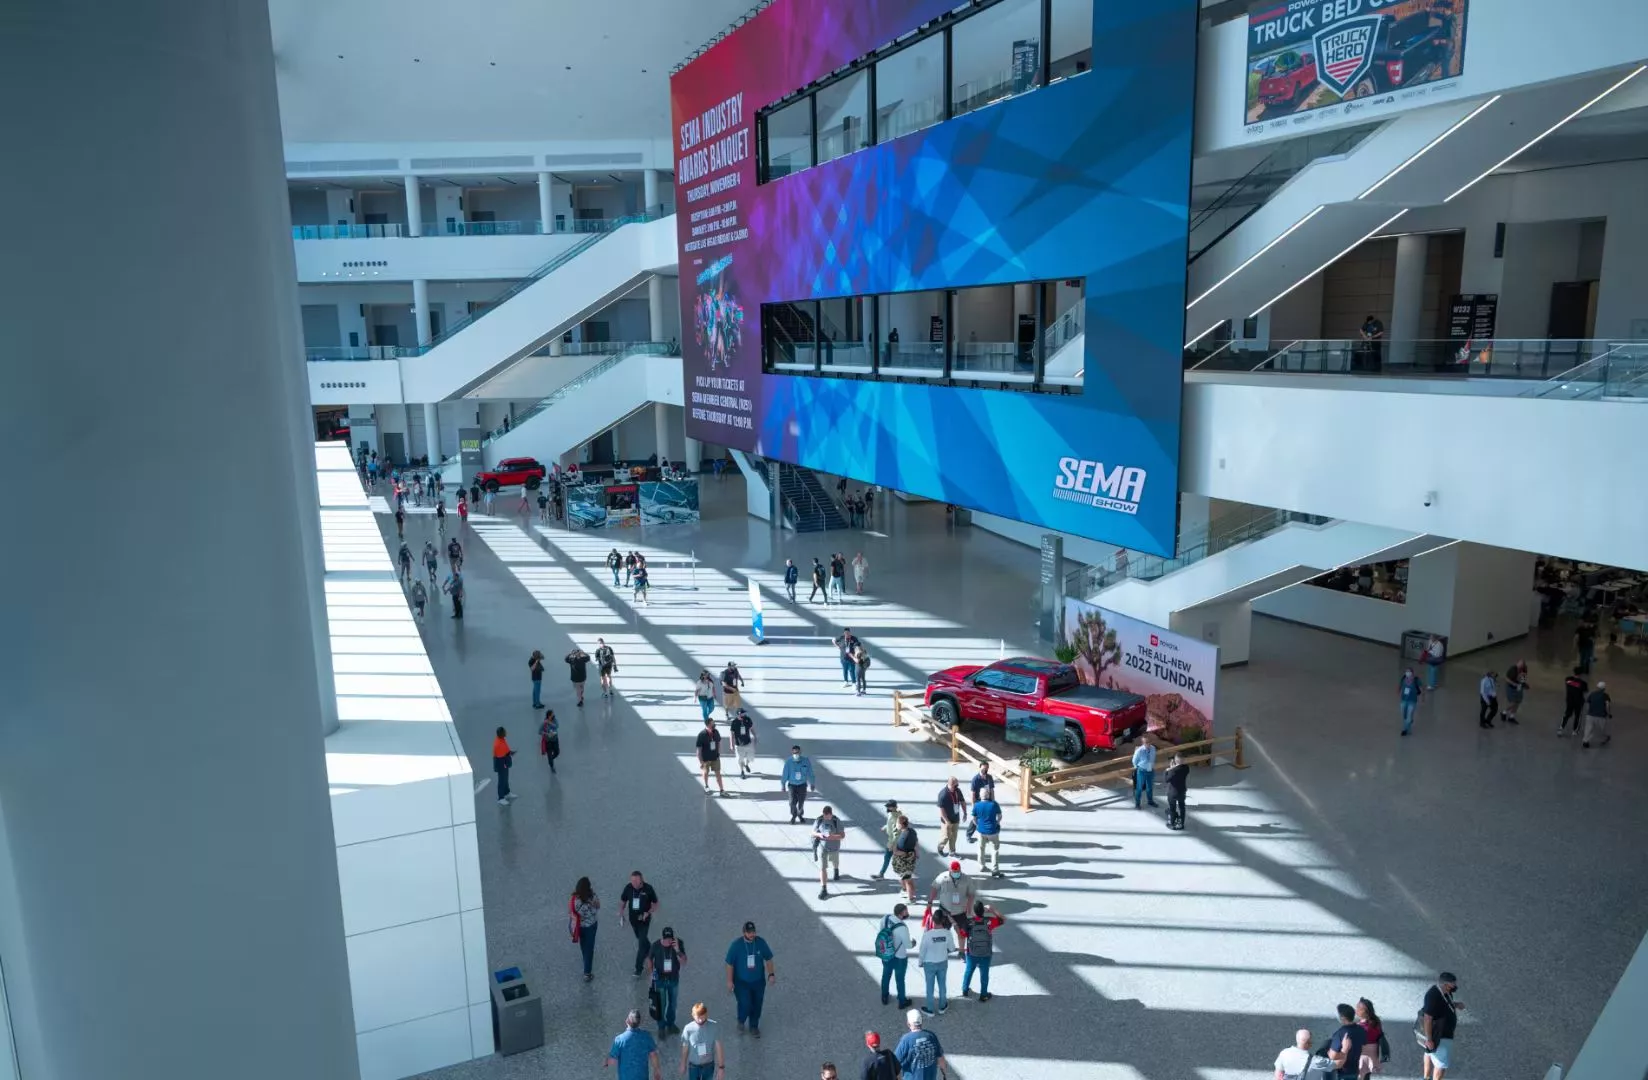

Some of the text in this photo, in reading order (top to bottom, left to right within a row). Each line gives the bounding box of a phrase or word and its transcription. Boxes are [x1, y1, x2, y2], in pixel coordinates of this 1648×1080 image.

[1254, 0, 1361, 44] TRUCK BED
[1323, 28, 1369, 51] TRUCK
[1326, 42, 1364, 64] HERO
[680, 92, 743, 152] SEMA INDUSTRY
[679, 127, 749, 185] AWARDS BANQUET
[1055, 456, 1147, 503] SEMA
[1095, 499, 1136, 512] SHOW
[1137, 645, 1192, 673] THE ALL-NEW
[1159, 640, 1178, 651] TOYOTA
[1125, 653, 1205, 696] 2022 TUNDRA
